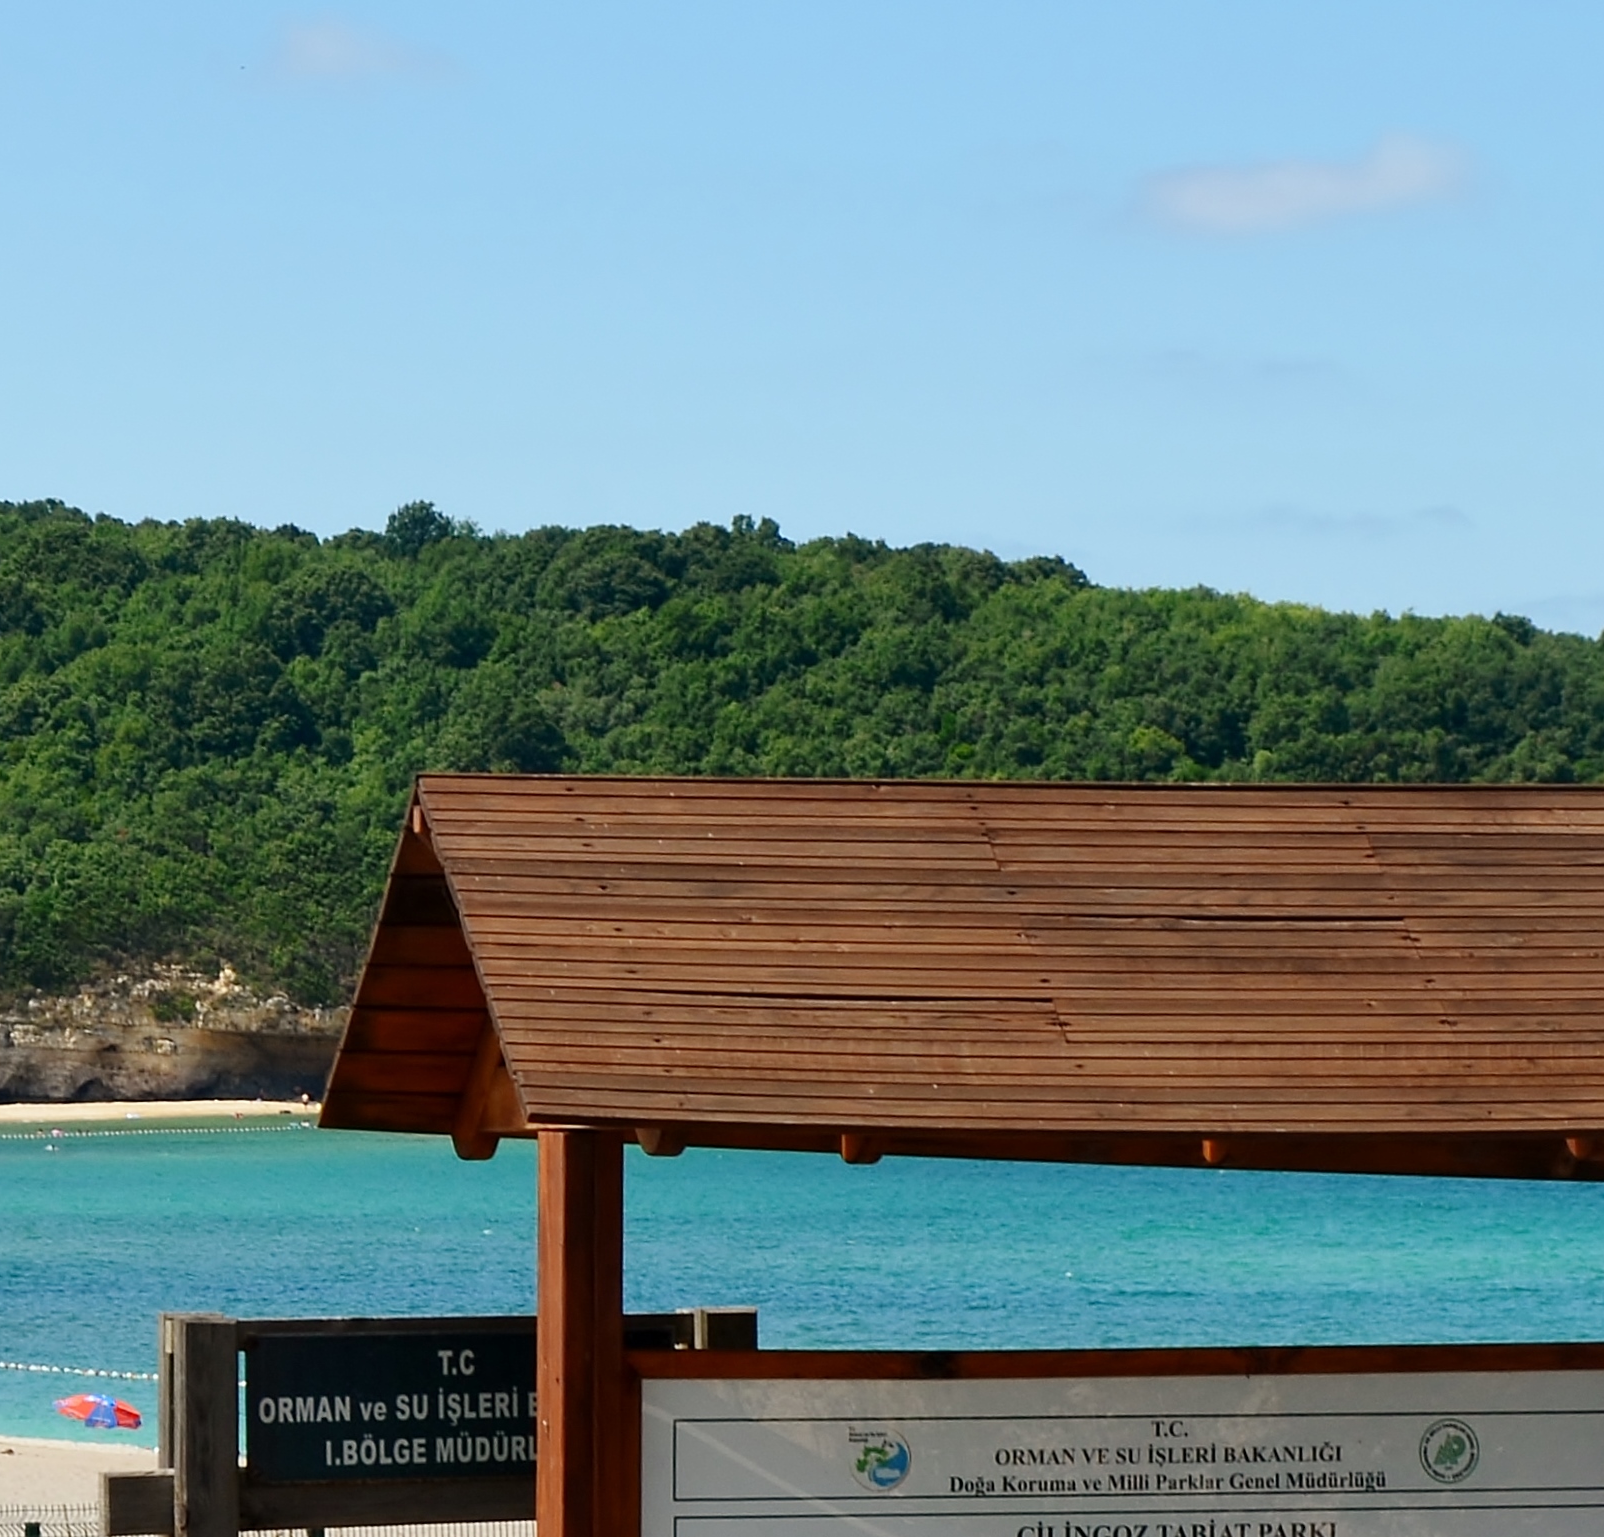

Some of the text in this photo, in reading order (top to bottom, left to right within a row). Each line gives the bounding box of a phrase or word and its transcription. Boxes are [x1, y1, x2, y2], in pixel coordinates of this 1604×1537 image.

[438, 1349, 476, 1377] T.C
[259, 1396, 351, 1424] ORMAN
[360, 1401, 387, 1422] ve
[395, 1394, 429, 1422] SU
[438, 1387, 519, 1427] İŞLERİ
[1151, 1420, 1189, 1439] T.C.
[435, 1429, 538, 1465] MÜDÜRL
[994, 1442, 1343, 1469] ORMAN VE SU İŞLERİ BAKANLIĞI
[949, 1470, 1388, 1498] Doğa Koruma ve Milli Parklar Genel Müdürlüğü
